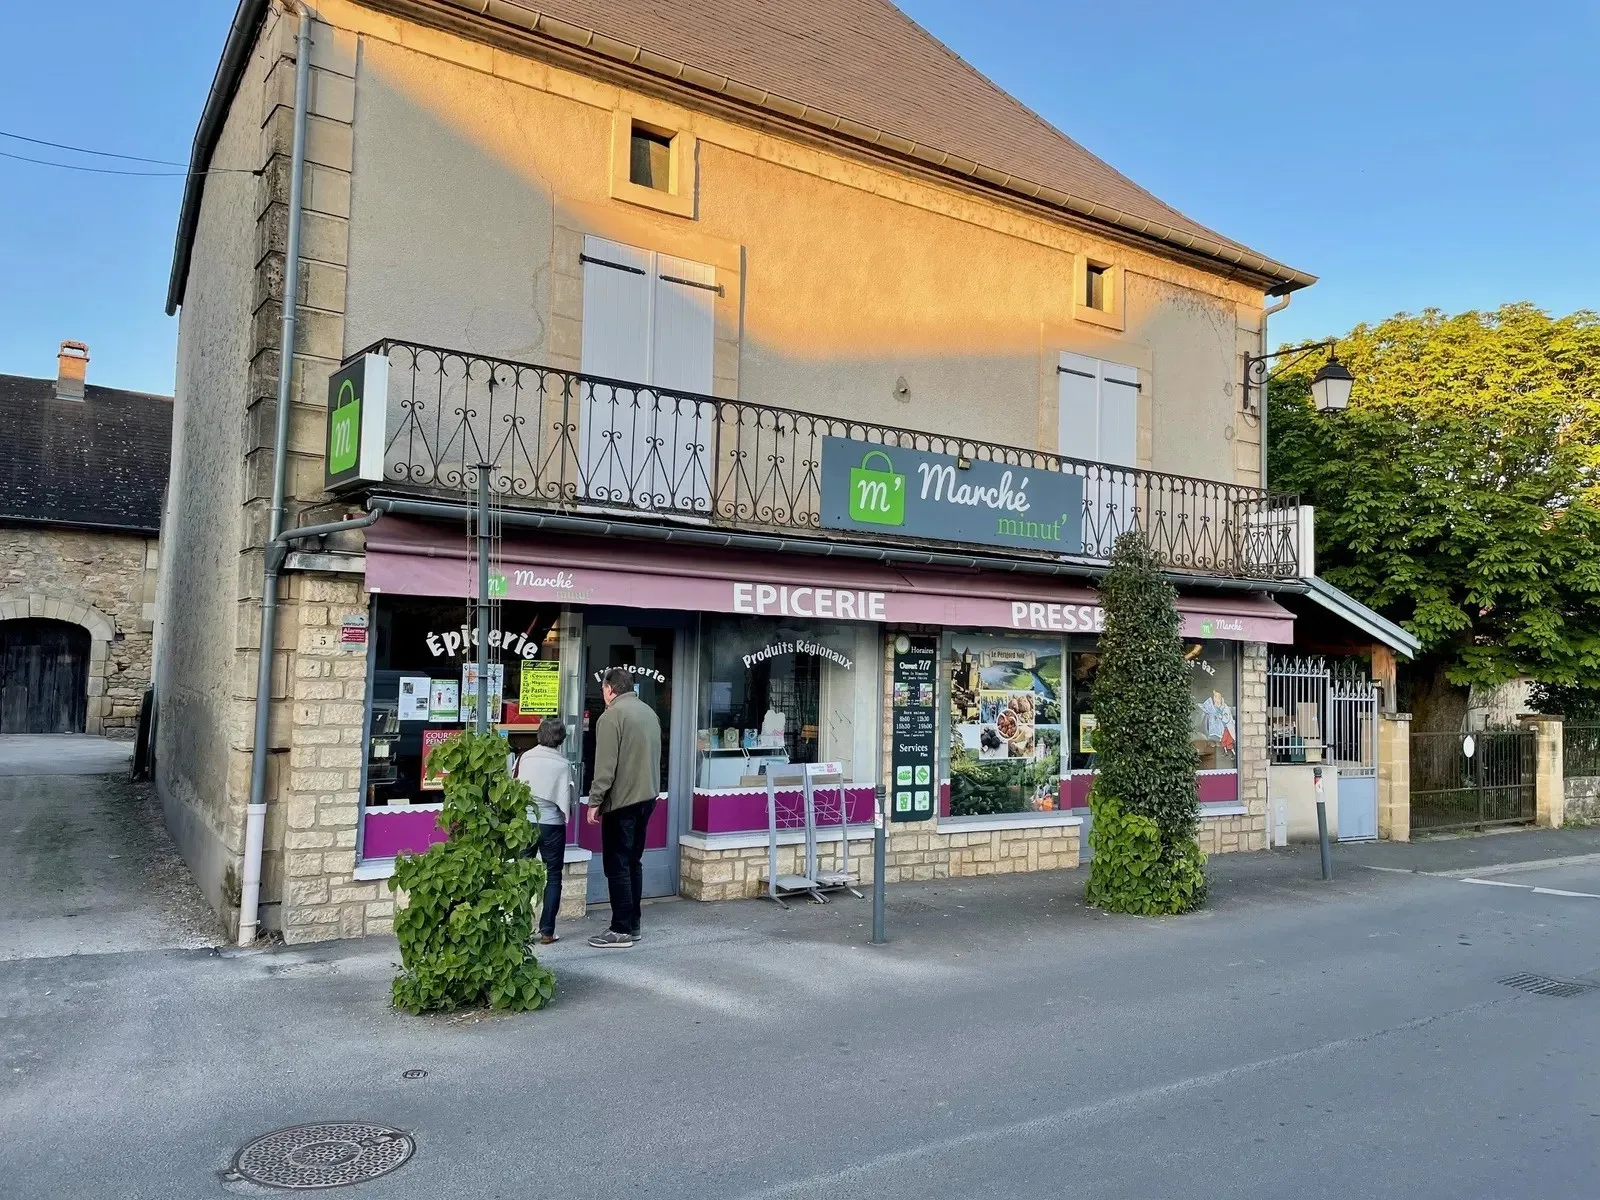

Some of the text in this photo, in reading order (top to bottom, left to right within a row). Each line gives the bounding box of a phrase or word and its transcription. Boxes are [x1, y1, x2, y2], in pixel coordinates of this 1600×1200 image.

[917, 462, 1031, 513] Marché
[997, 512, 1068, 541] minut'
[513, 569, 574, 589] Marché
[733, 582, 887, 621] EPICERIE
[1215, 618, 1244, 631] Marché
[319, 635, 327, 646] 5
[742, 639, 854, 670] Produits Régionaux
[911, 646, 934, 654] Horaires
[1201, 660, 1216, 676] Gaz
[899, 743, 929, 753] Services
